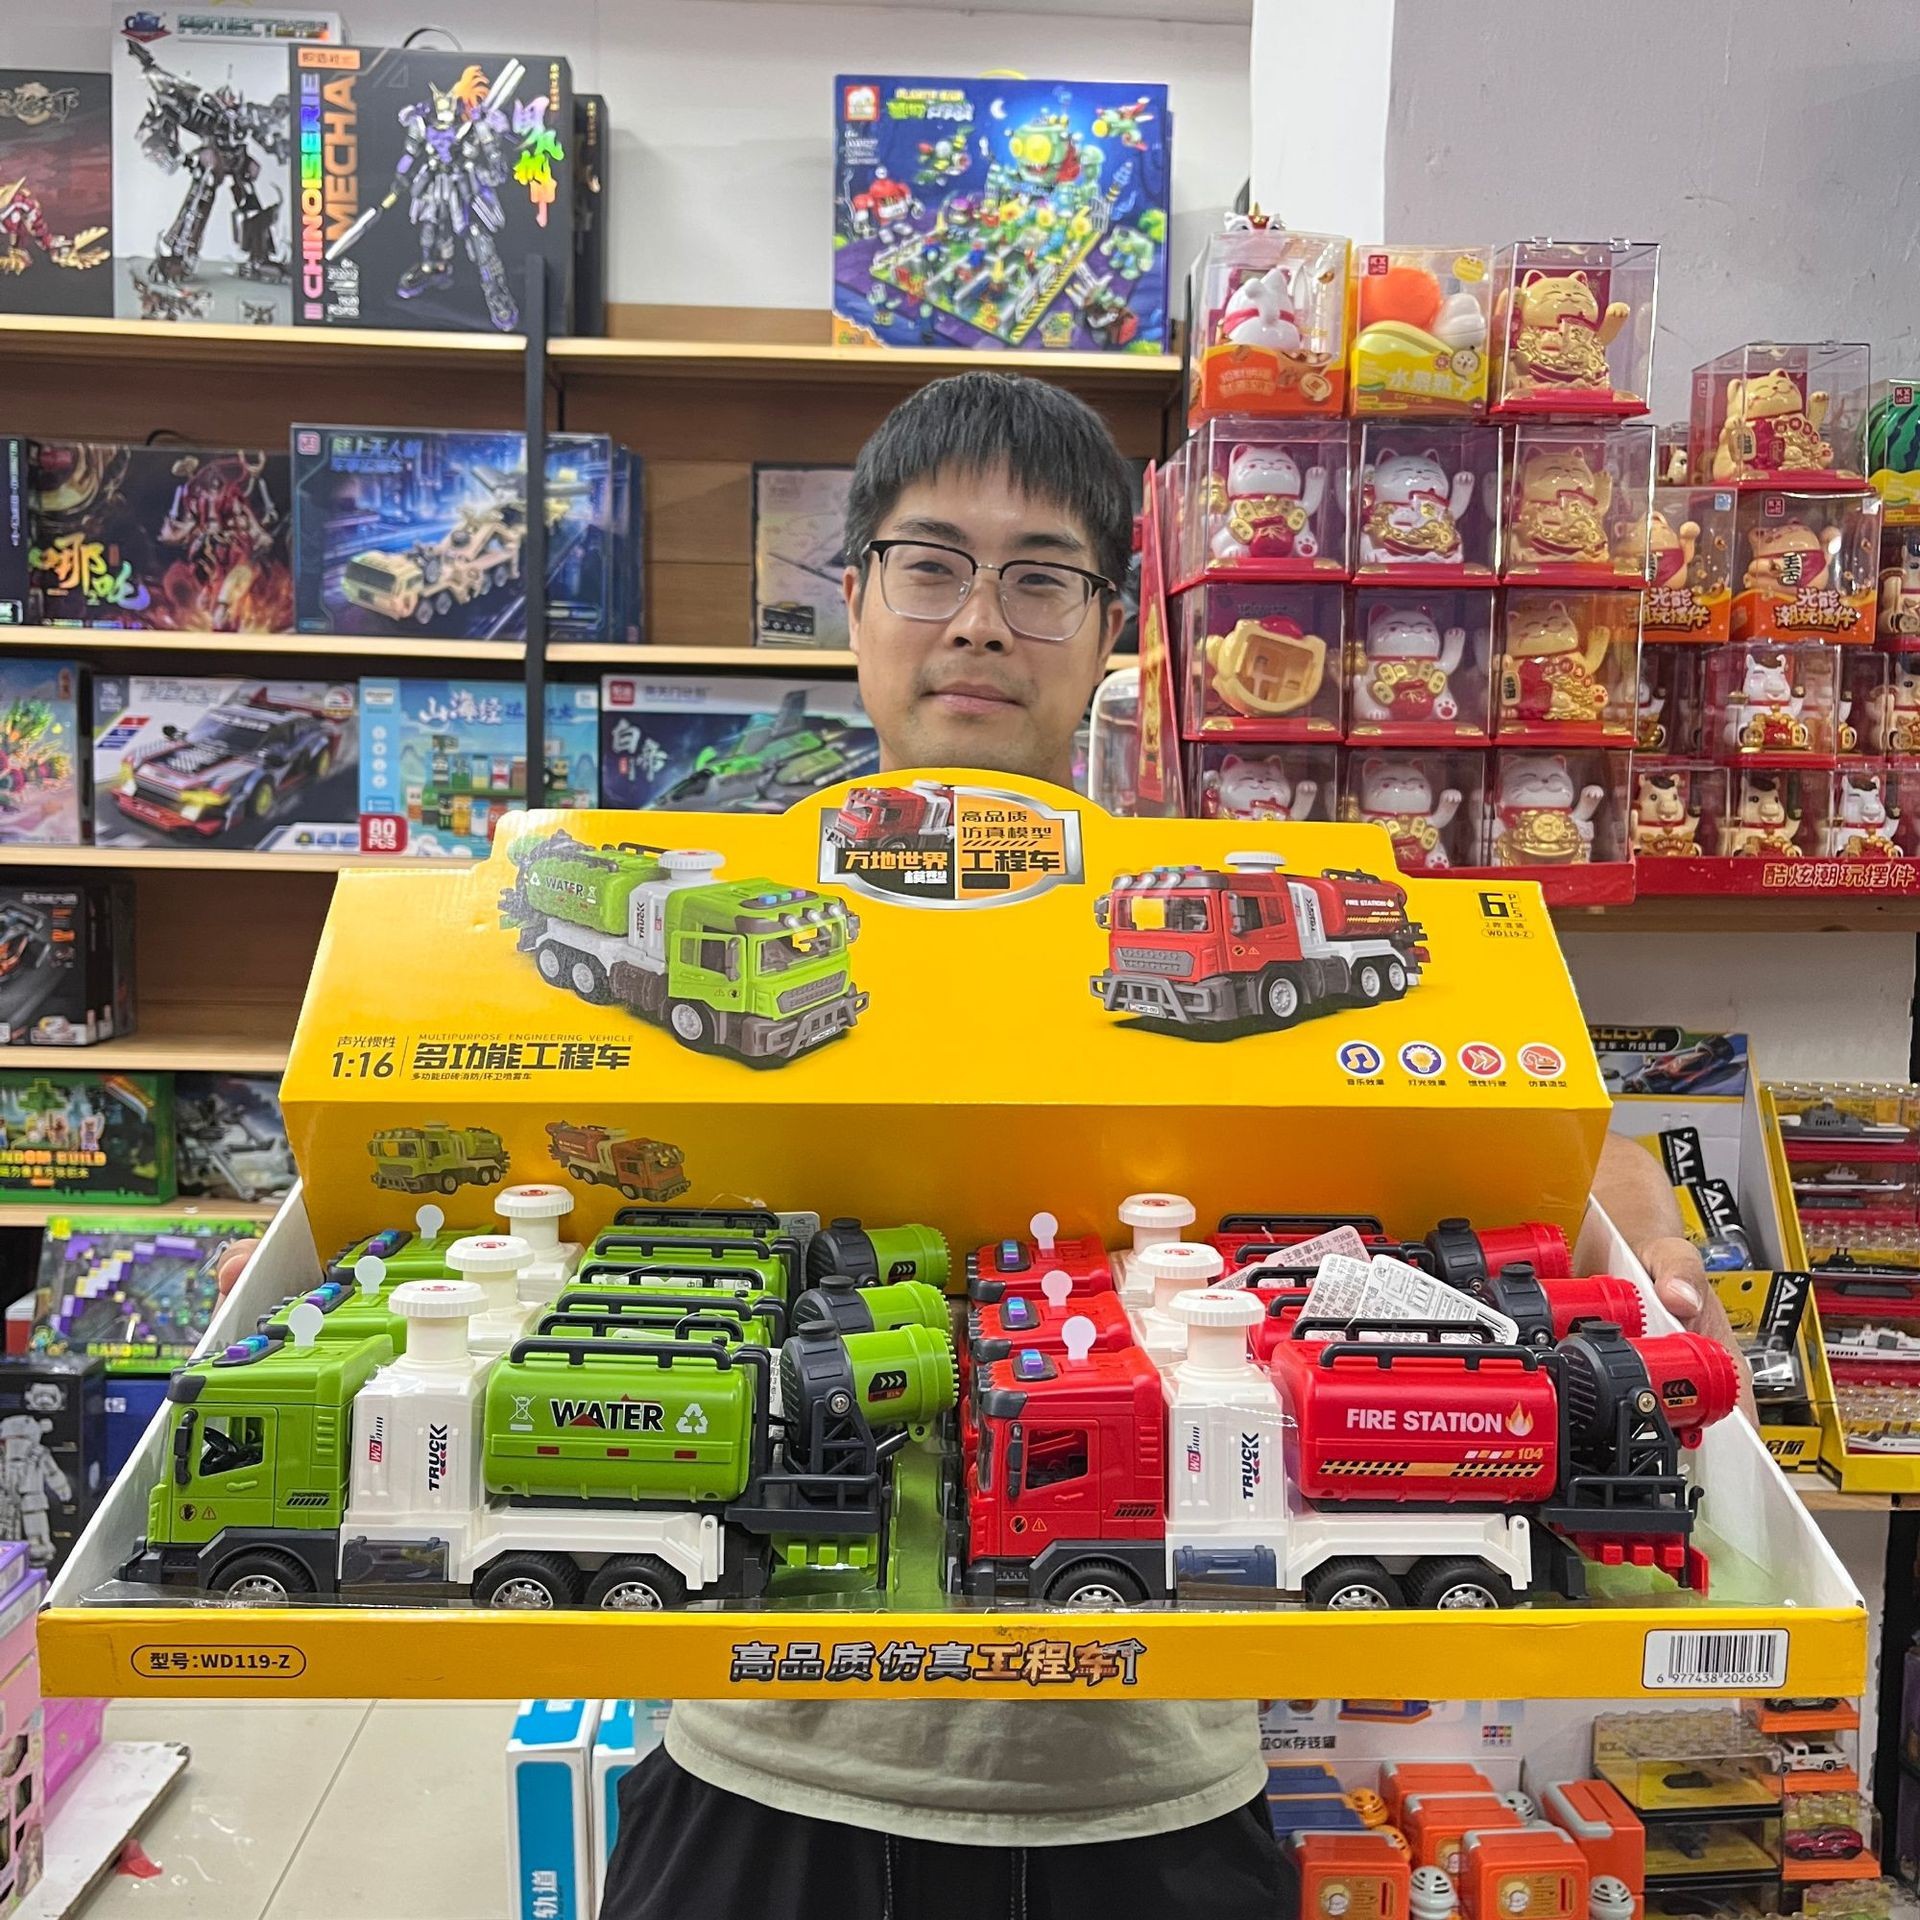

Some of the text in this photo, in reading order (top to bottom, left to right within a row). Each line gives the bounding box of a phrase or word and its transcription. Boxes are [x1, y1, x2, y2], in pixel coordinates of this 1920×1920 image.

[323, 76, 358, 241] MECHA
[367, 818, 398, 836] 80
[961, 810, 1028, 823] 高品质
[367, 837, 397, 850] PCS
[961, 826, 1052, 840] 仿真模型
[845, 850, 948, 870] 万地世界
[961, 849, 1060, 873] 工程车
[546, 876, 585, 898] WATER
[903, 870, 948, 885] 模型
[1762, 863, 1916, 888] 酷炫潮玩摆件
[1478, 892, 1510, 918] 6
[418, 1033, 502, 1041] MULTIPURPOSE
[508, 1034, 583, 1042] ENGINEERING
[332, 1051, 395, 1078] 1:16
[413, 1042, 632, 1070] 多功能工程车
[550, 1399, 665, 1432] WATER
[1347, 1408, 1503, 1433] FIRE STATION
[428, 1423, 448, 1492] TRUCK
[1517, 1447, 1544, 1460] 104
[1241, 1432, 1260, 1500] TRUCK
[149, 1650, 291, 1671] 型号:WD119-Z
[729, 1638, 1140, 1686] 高品质仿真工程车
[1656, 1672, 1770, 1684] 6 977438 202655
